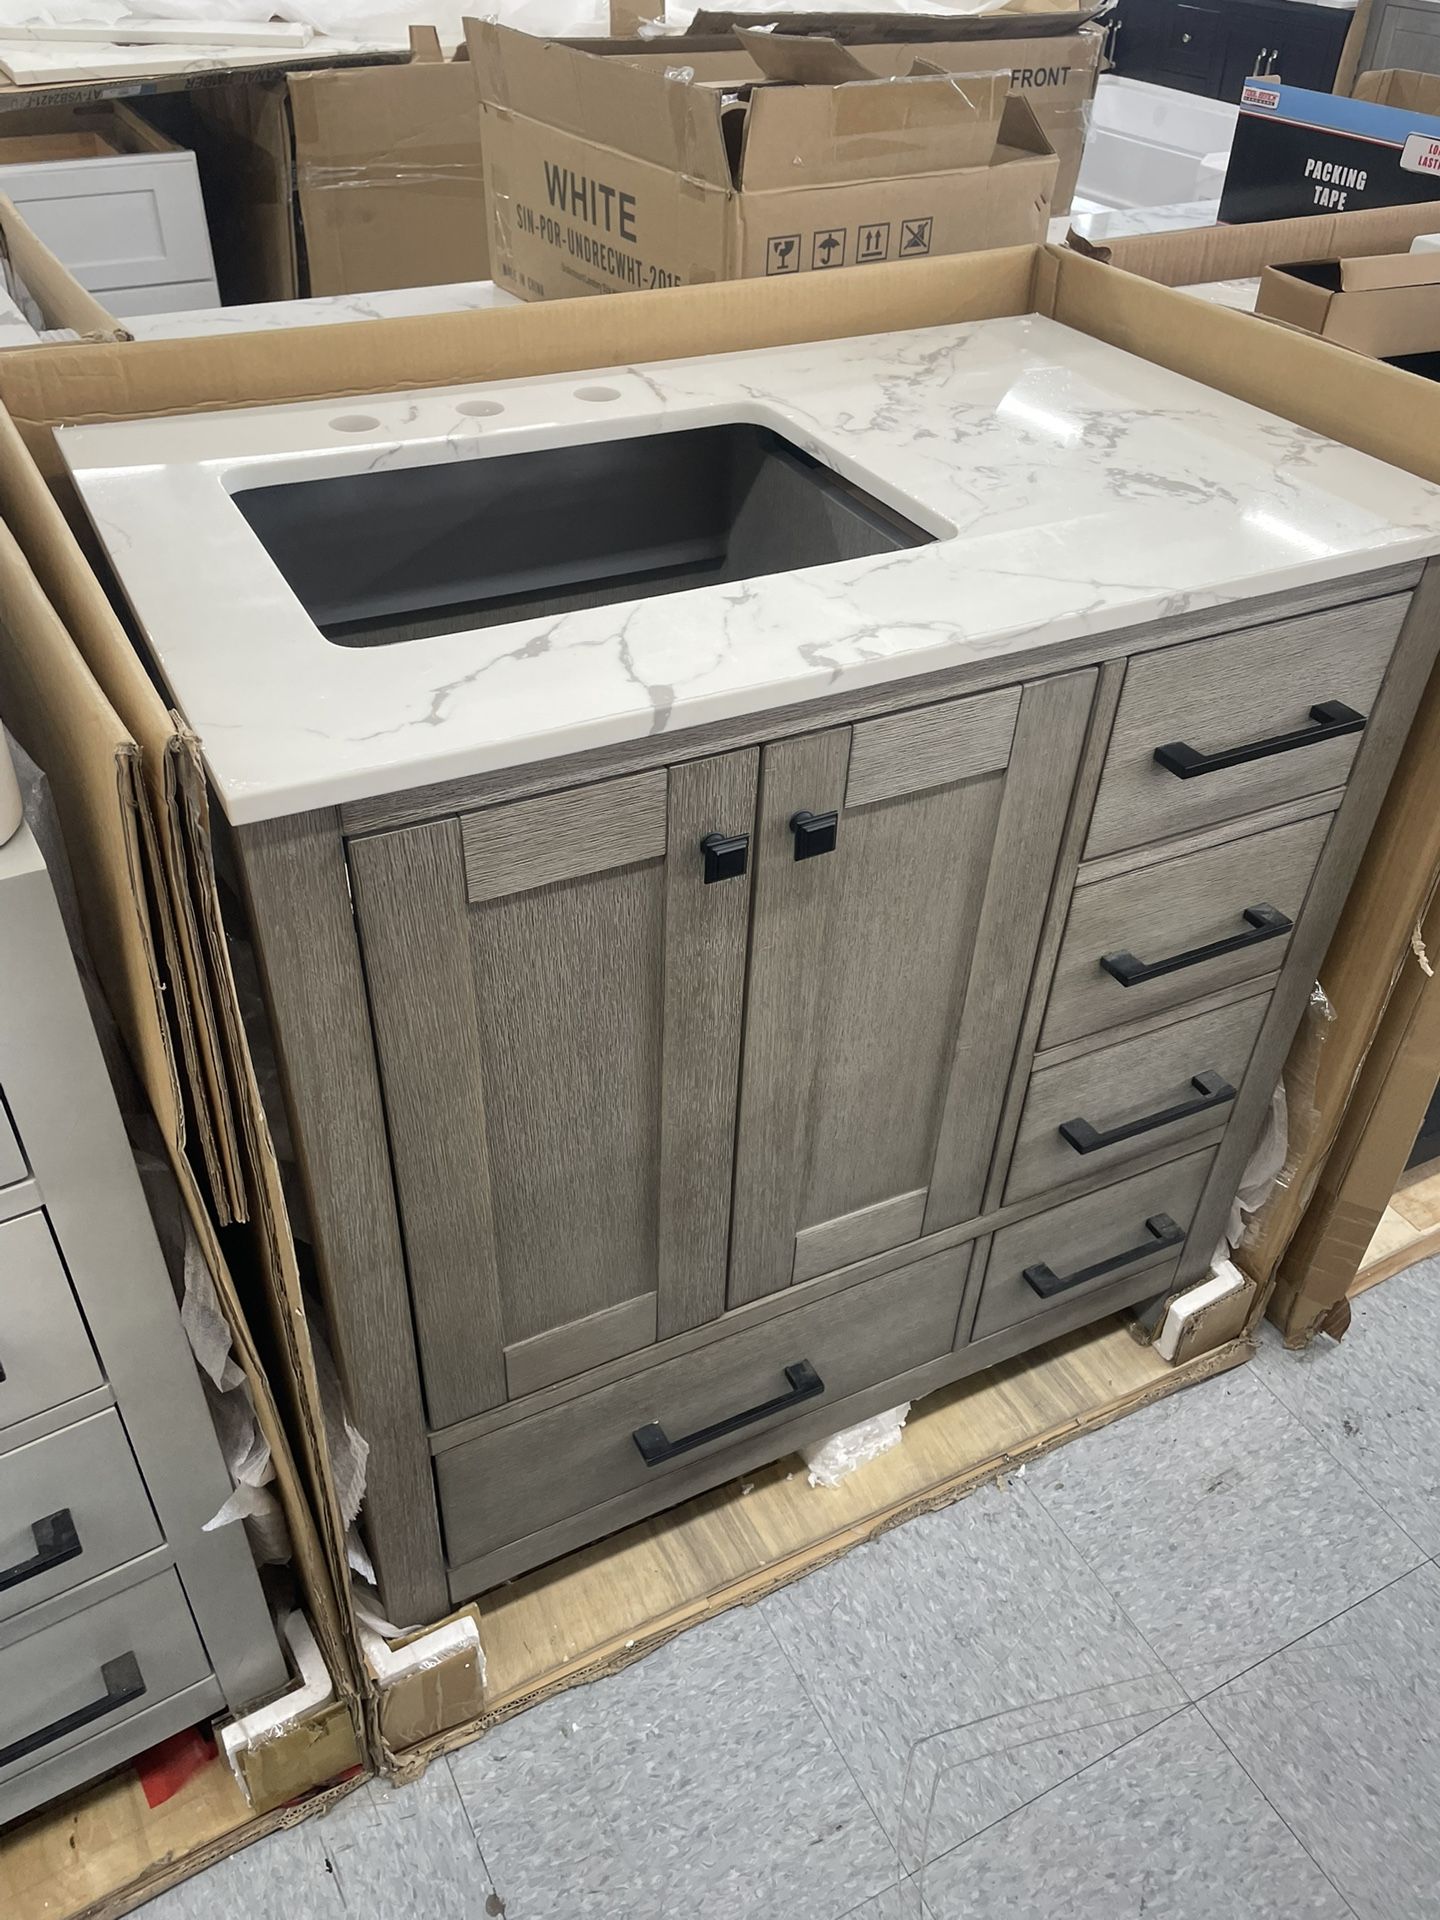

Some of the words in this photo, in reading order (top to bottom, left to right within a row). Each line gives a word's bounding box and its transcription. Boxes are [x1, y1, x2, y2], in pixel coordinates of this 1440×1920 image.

[1010, 66, 1071, 88] FRONT
[1428, 143, 1440, 156] LO
[1304, 158, 1368, 191] PACKING
[544, 160, 637, 243] WHITE
[1313, 185, 1348, 211] TAPE
